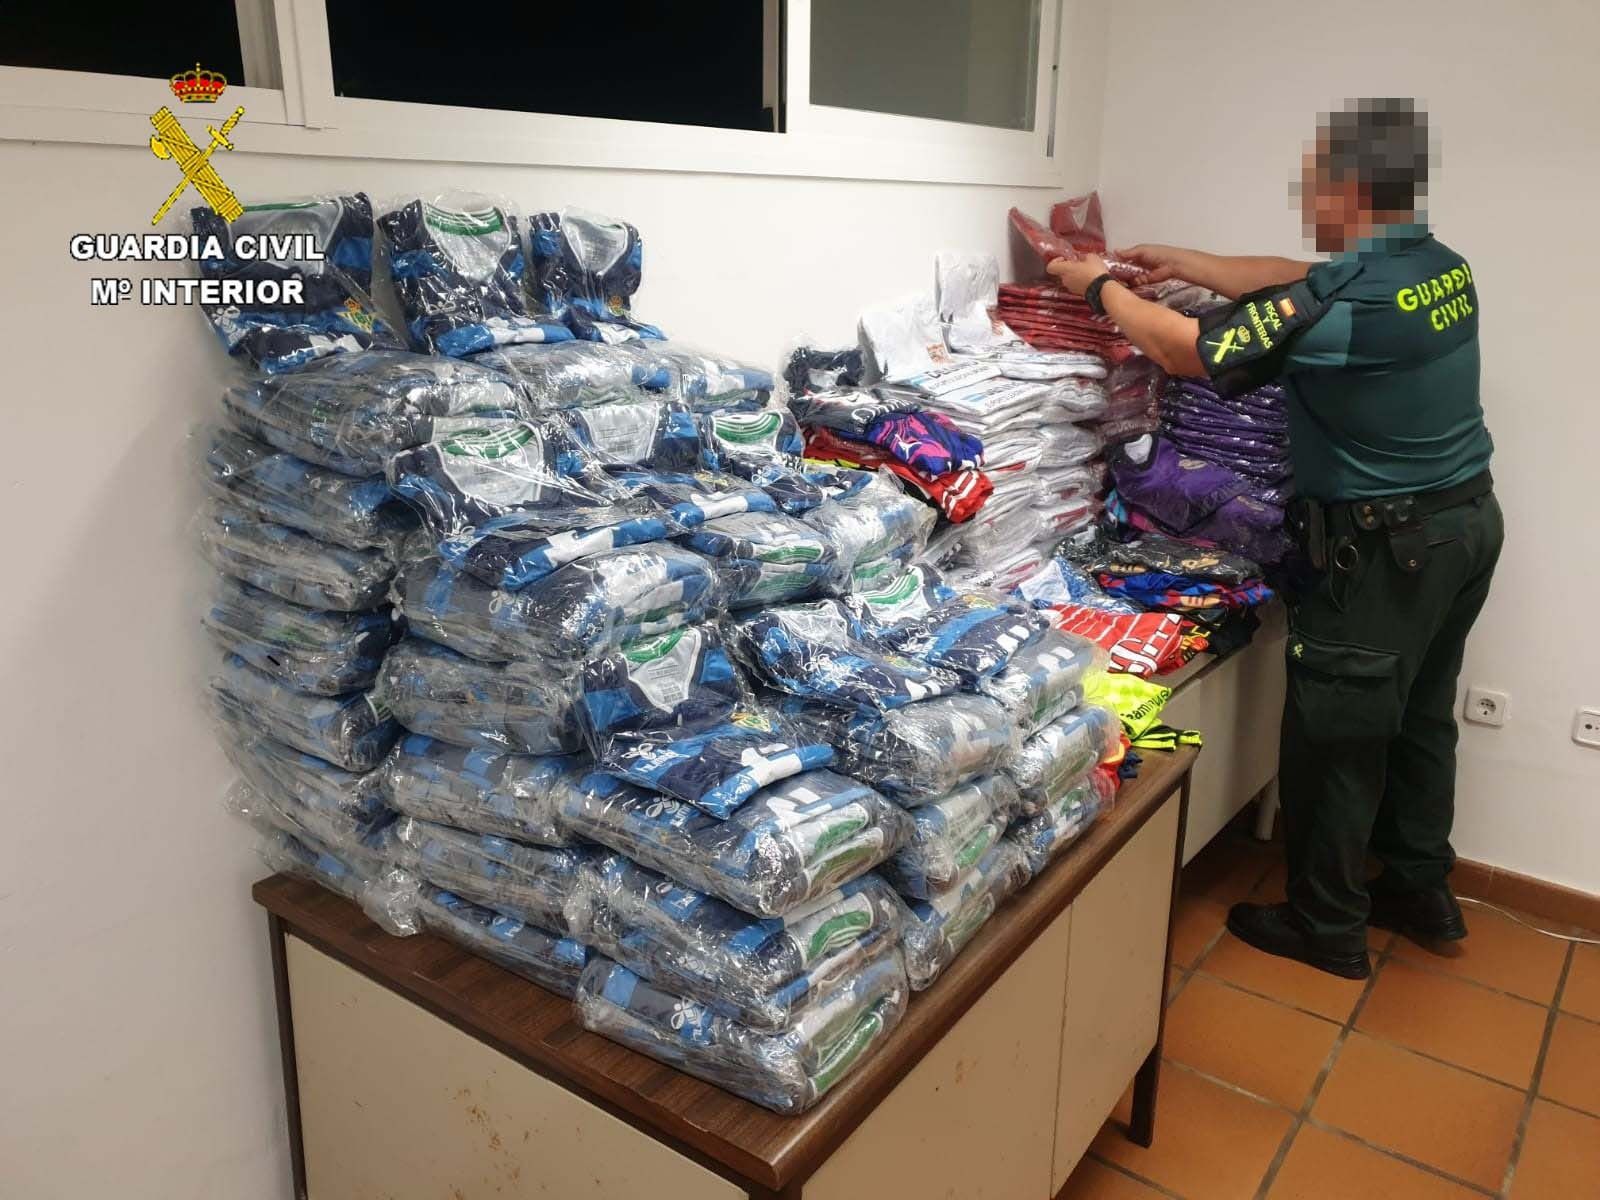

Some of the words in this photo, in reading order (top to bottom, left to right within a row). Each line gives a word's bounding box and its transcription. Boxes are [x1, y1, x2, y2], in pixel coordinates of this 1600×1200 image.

[1396, 263, 1473, 311] GUARDI
[1245, 302, 1274, 349] FRONTERAS
[1263, 300, 1283, 331] FISCAL
[1431, 293, 1473, 331] CIVIL
